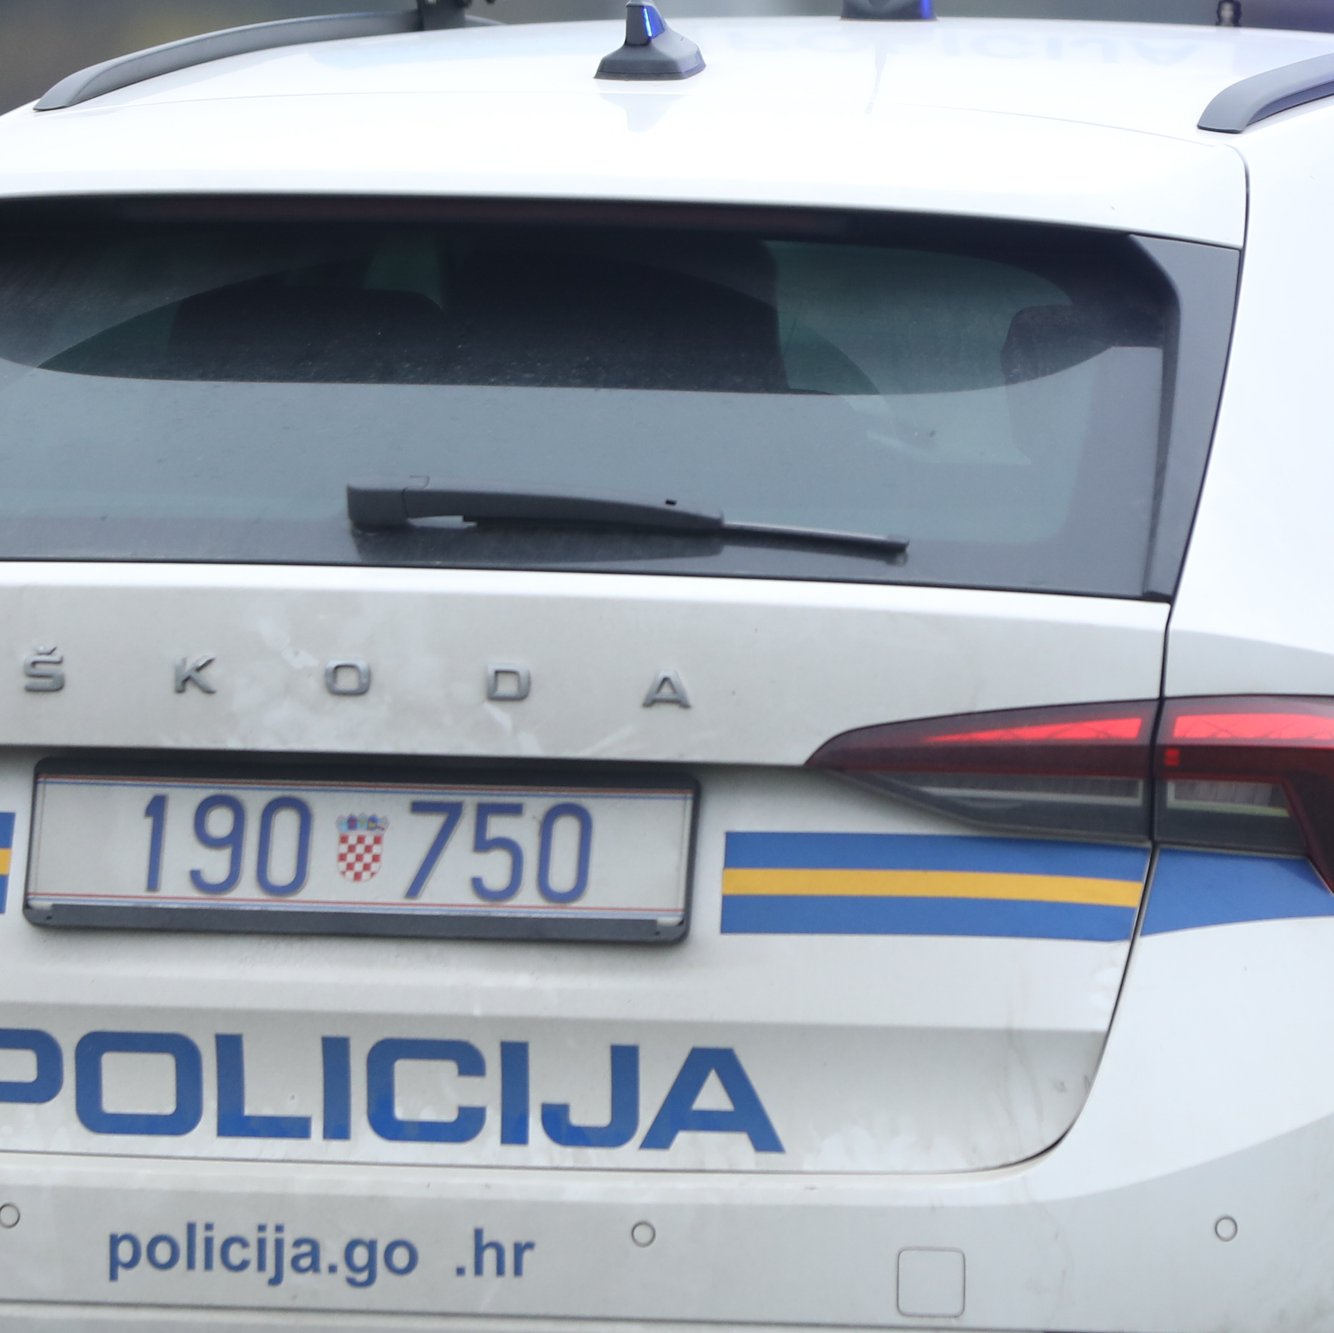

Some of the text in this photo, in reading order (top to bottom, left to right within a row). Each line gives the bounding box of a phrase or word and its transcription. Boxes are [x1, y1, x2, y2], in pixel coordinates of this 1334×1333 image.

[22, 646, 693, 709] ŠKODA
[144, 793, 594, 905] 190 750
[108, 1221, 420, 1289] policija.go
